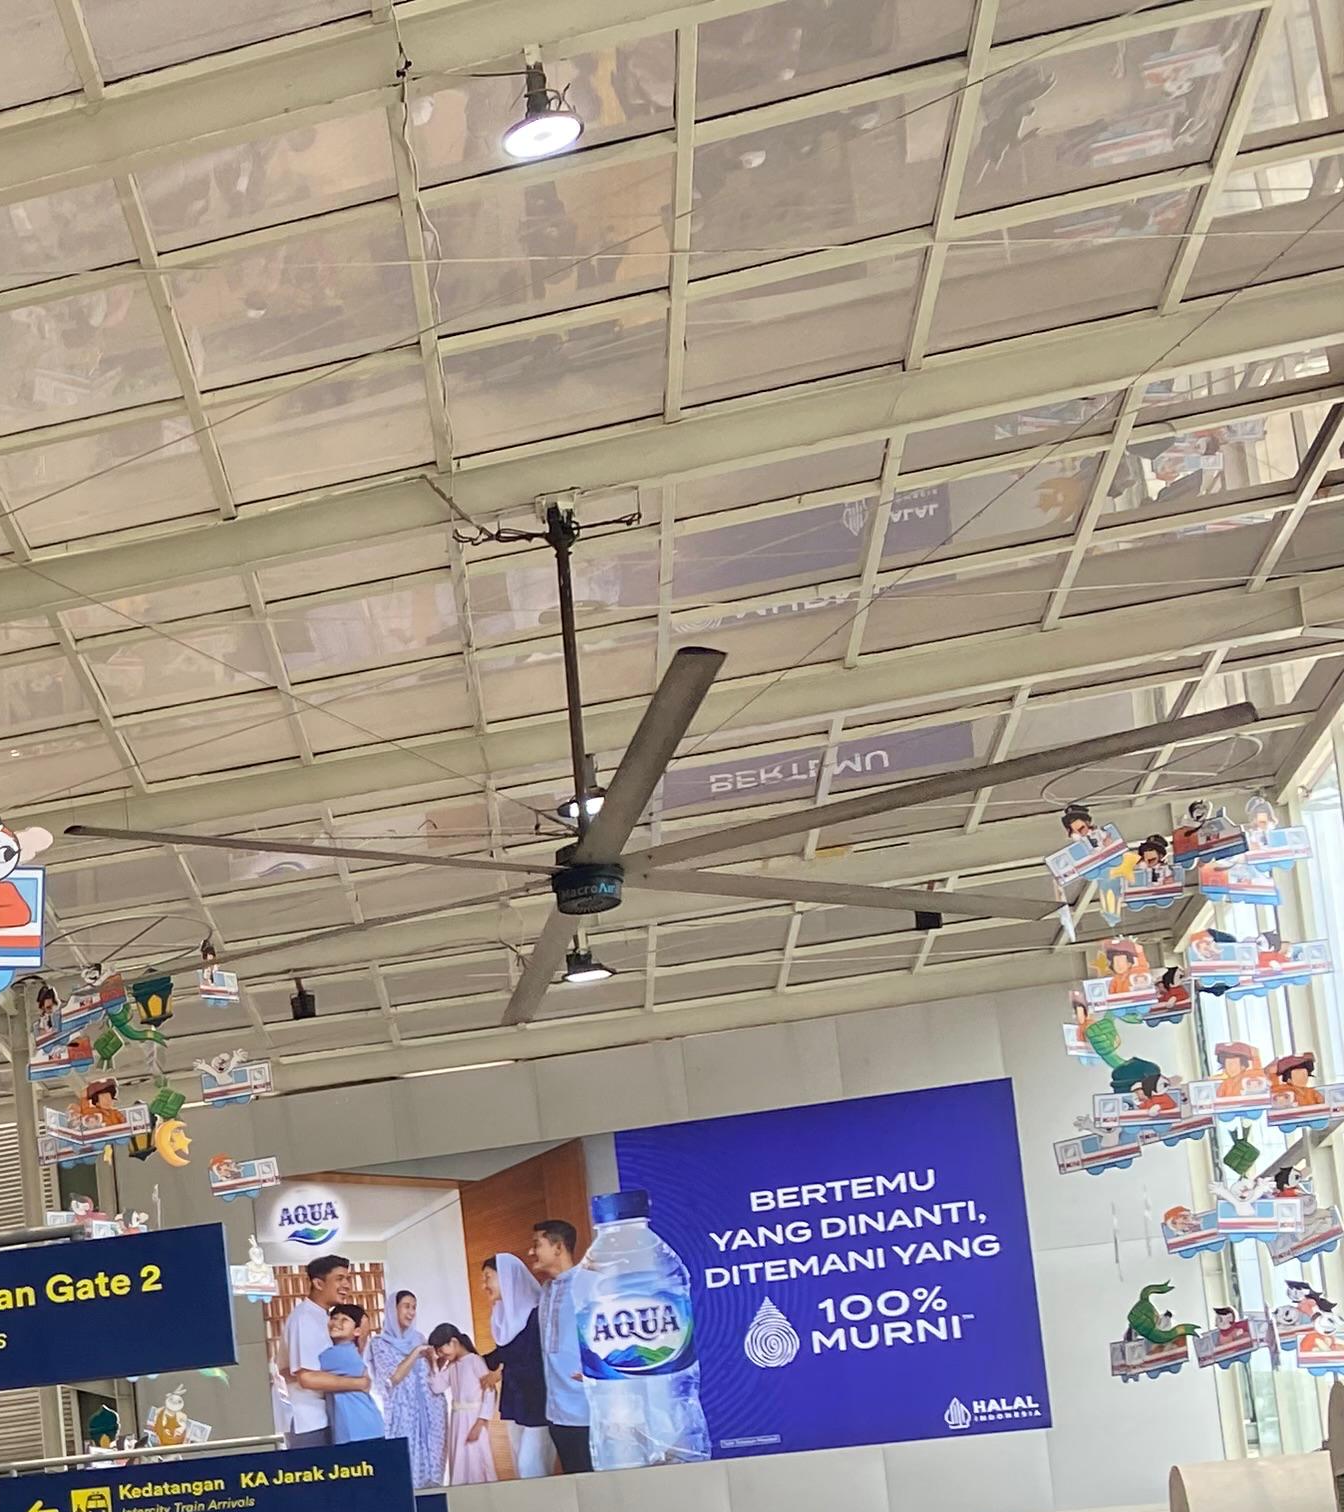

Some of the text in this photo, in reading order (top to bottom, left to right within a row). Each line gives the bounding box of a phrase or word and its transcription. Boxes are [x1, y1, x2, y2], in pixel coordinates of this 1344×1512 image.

[749, 1168, 937, 1213] BERTEMU
[278, 1201, 340, 1227] AQUA
[708, 1198, 989, 1254] YANG DINANTI,
[703, 1232, 1002, 1291] DITEMANI YANG
[44, 1271, 135, 1304] Gate
[140, 1264, 164, 1293] 2
[817, 1284, 949, 1325] 100%
[592, 1301, 681, 1348] AQUA
[972, 1396, 1040, 1414] HALAL
[973, 1409, 1042, 1423] INDONESIA
[117, 1460, 375, 1501] Kedatangan KA Jarak Jauh
[207, 1495, 256, 1512] Arrivals
